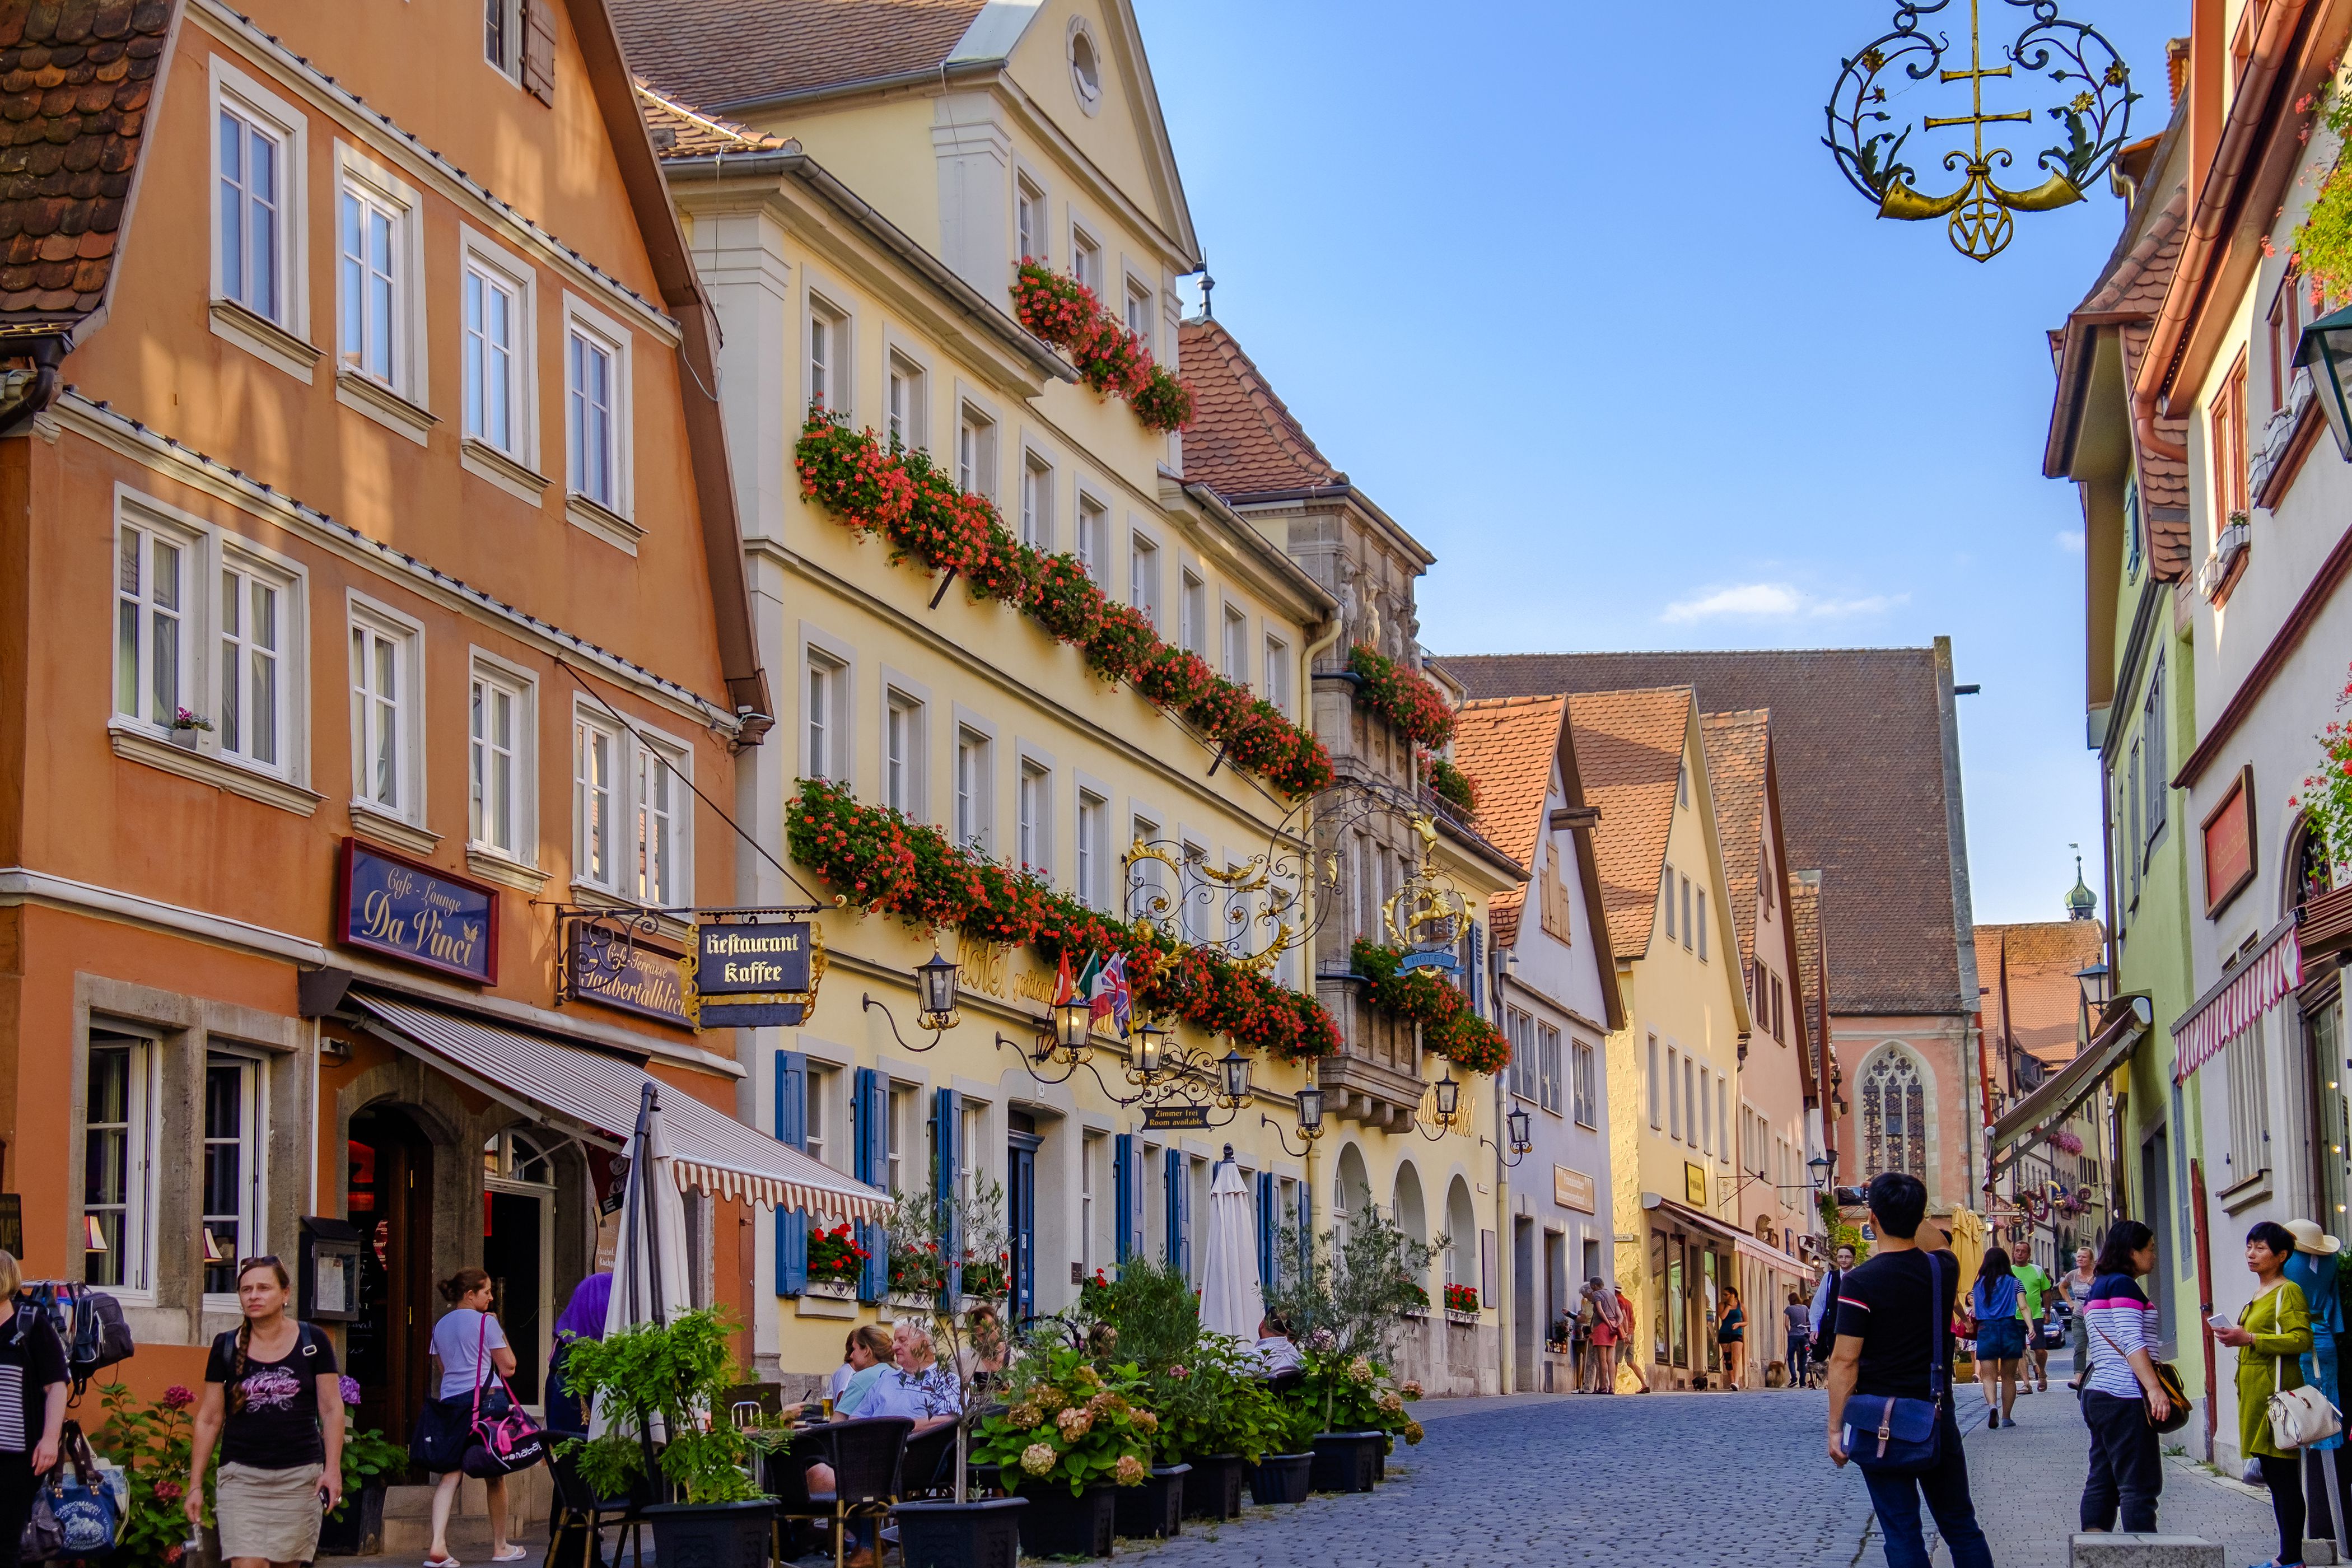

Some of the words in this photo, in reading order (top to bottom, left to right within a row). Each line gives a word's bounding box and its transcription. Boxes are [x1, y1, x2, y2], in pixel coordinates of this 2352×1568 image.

[388, 867, 412, 899] Cafe
[421, 881, 461, 917] Lounge
[362, 890, 407, 944] Da
[413, 908, 475, 967] Vinci
[724, 961, 782, 984] Kaffee
[956, 927, 1011, 999] Hotel
[1412, 954, 1446, 964] HOTEL
[54, 1501, 101, 1516] CAMPOMAGGI
